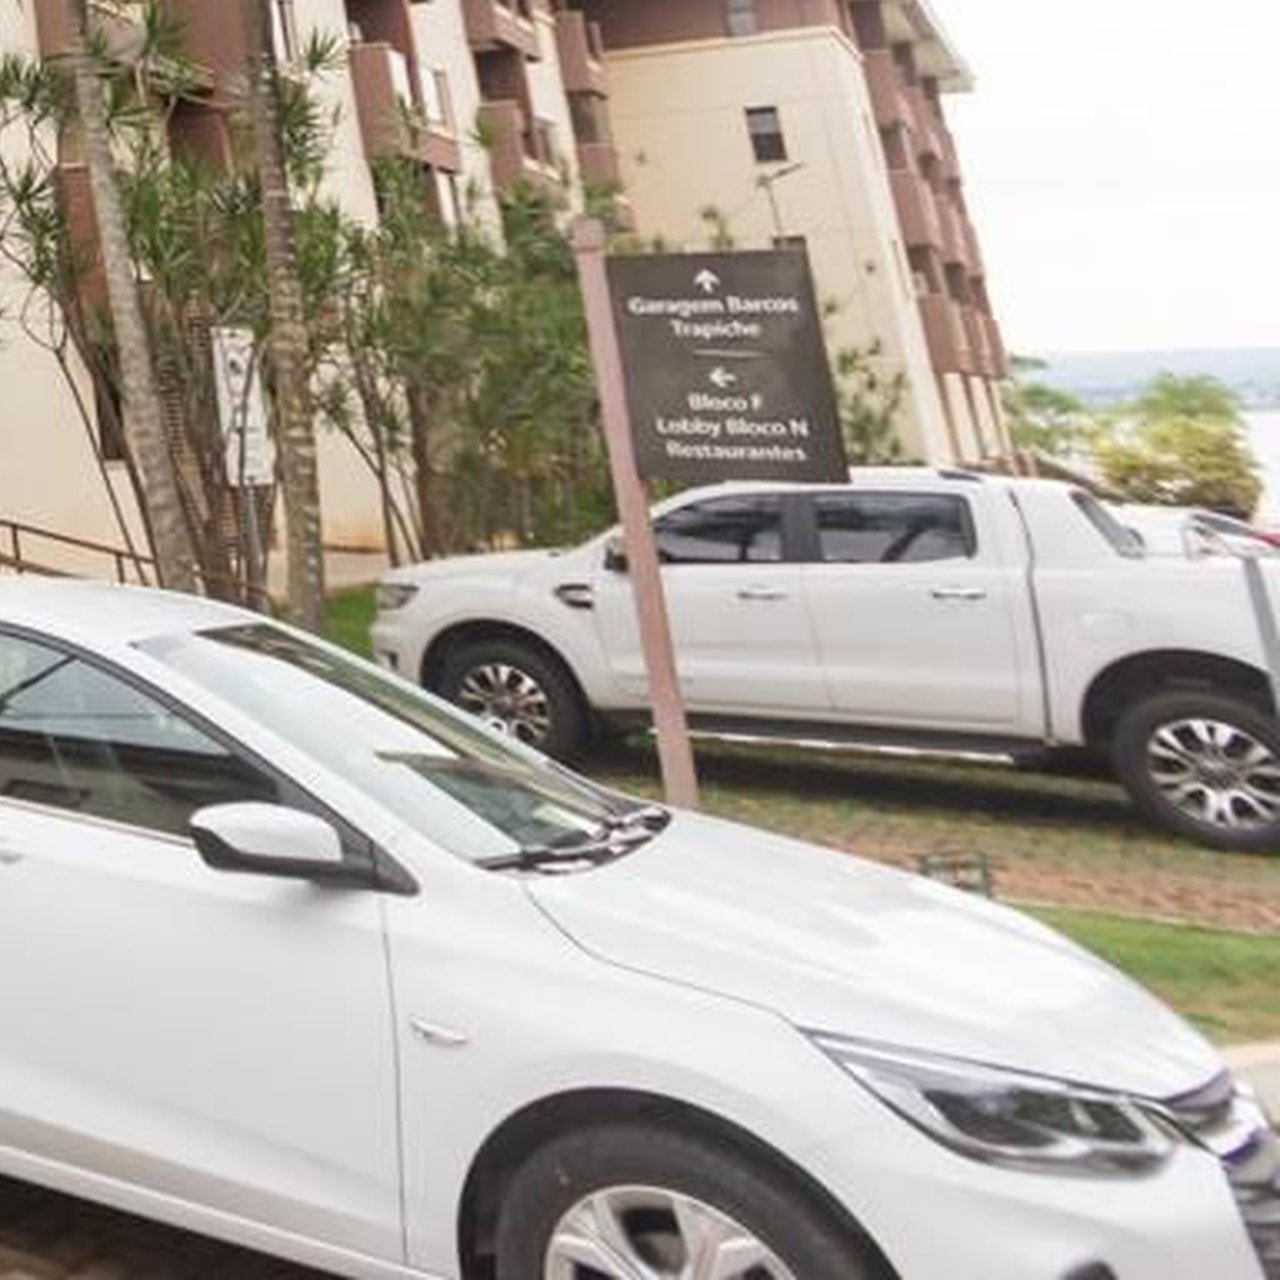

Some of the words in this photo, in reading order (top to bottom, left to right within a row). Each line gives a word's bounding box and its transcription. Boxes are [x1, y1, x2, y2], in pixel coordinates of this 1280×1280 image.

[627, 296, 723, 318] Garagem
[726, 295, 800, 314] Barcos
[670, 319, 762, 340] Trapiche
[687, 392, 748, 411] Bloco
[749, 393, 763, 411] F
[655, 417, 721, 438] Lobby
[725, 418, 786, 436] Bloco
[788, 418, 809, 437] N
[665, 439, 807, 462] Restaurantes
